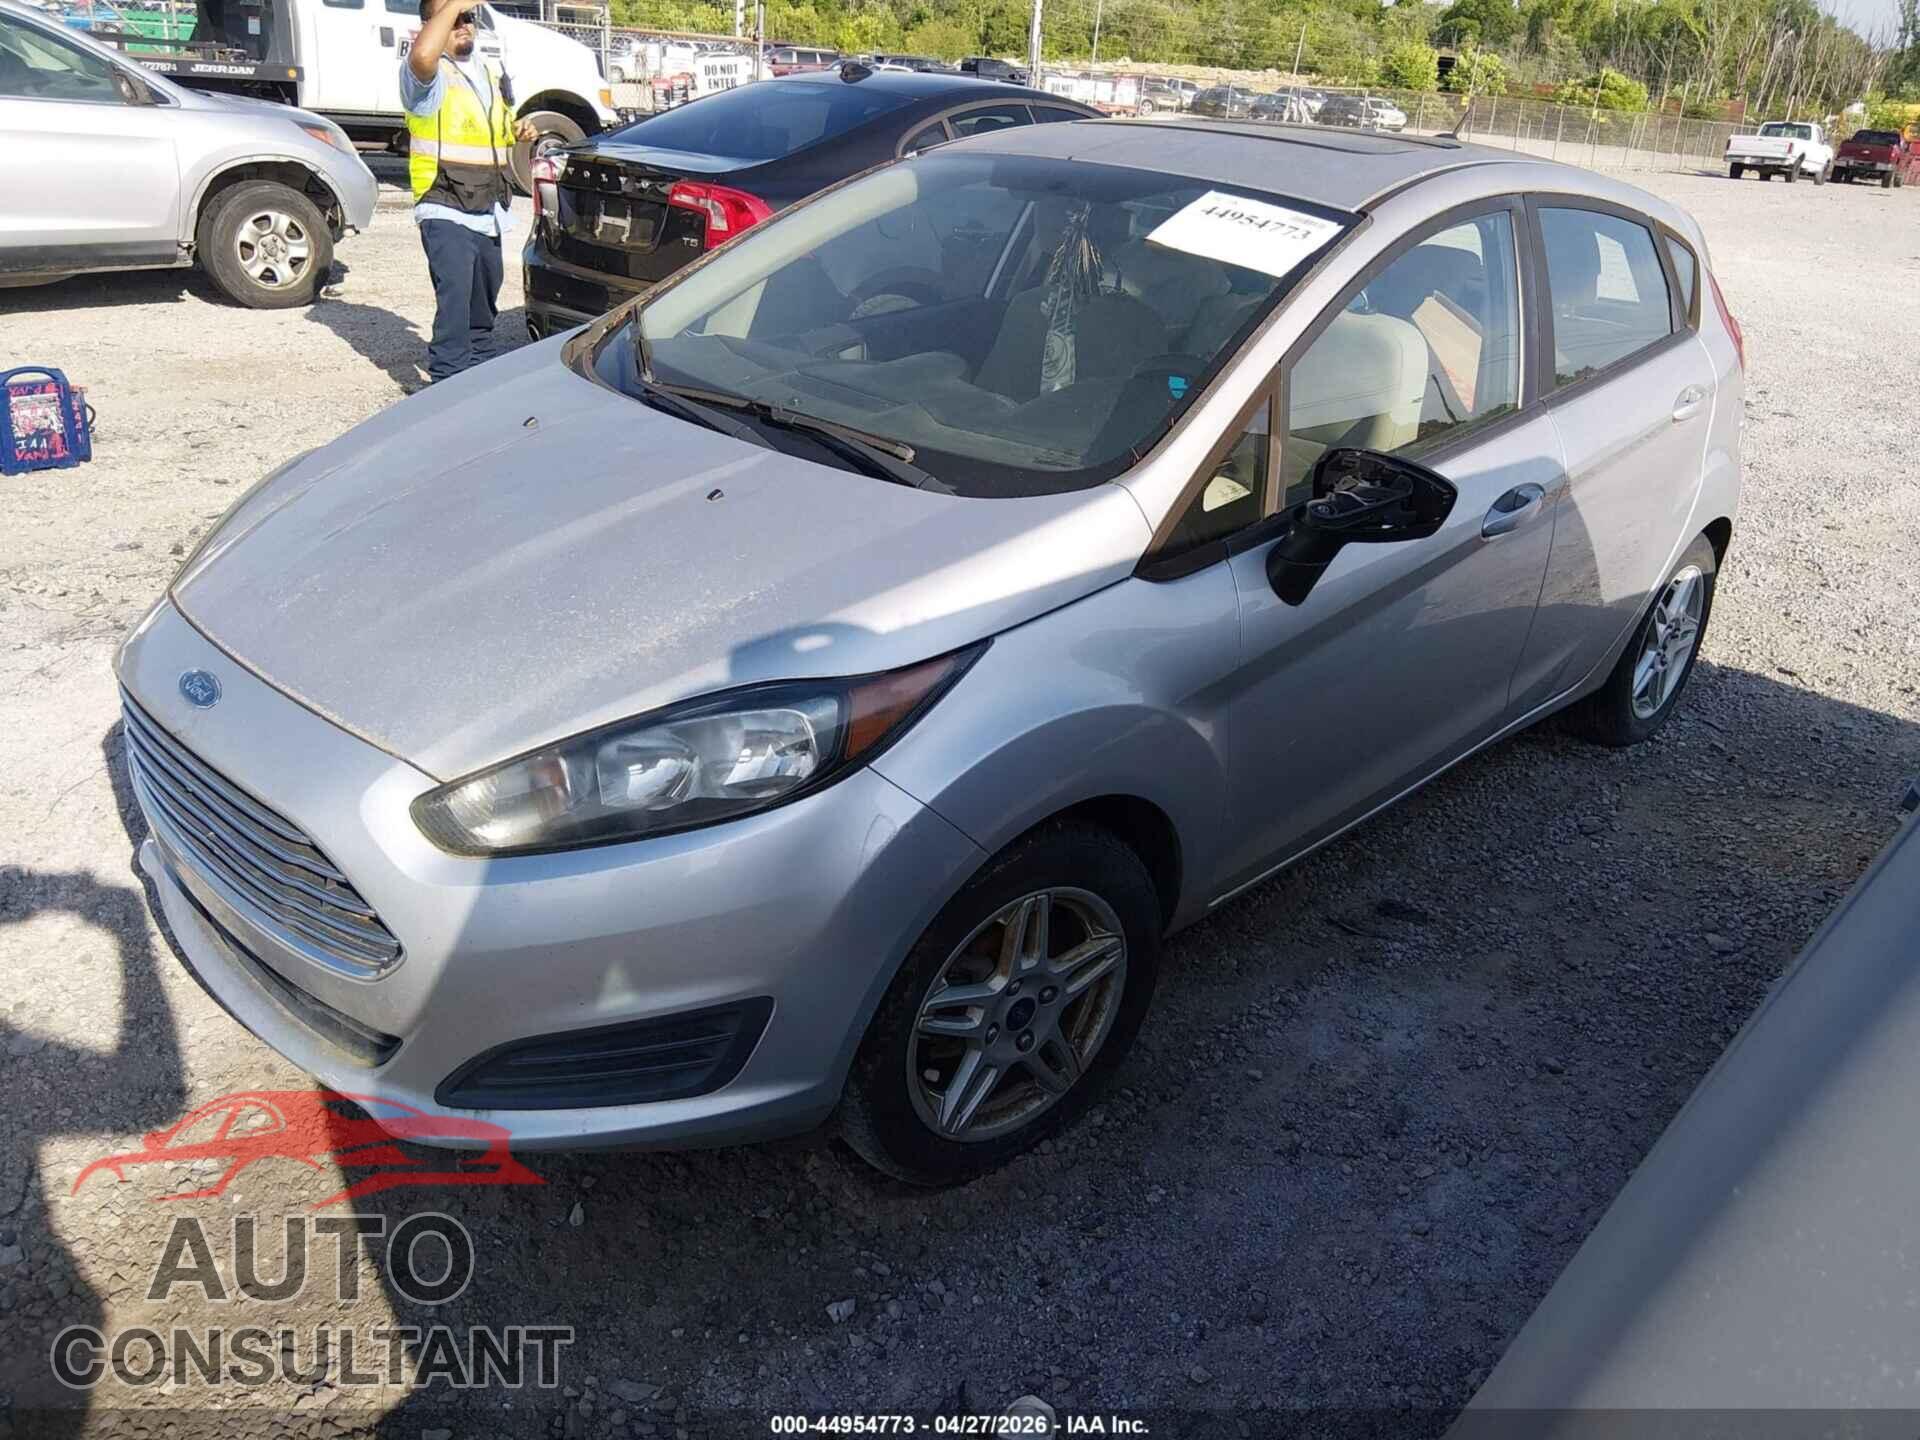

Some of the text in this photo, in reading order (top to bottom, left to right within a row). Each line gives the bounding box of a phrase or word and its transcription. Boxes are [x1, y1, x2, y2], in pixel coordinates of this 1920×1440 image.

[704, 64, 738, 75] DO NOT
[708, 78, 737, 89] ENTER
[1201, 205, 1312, 240] 44954773
